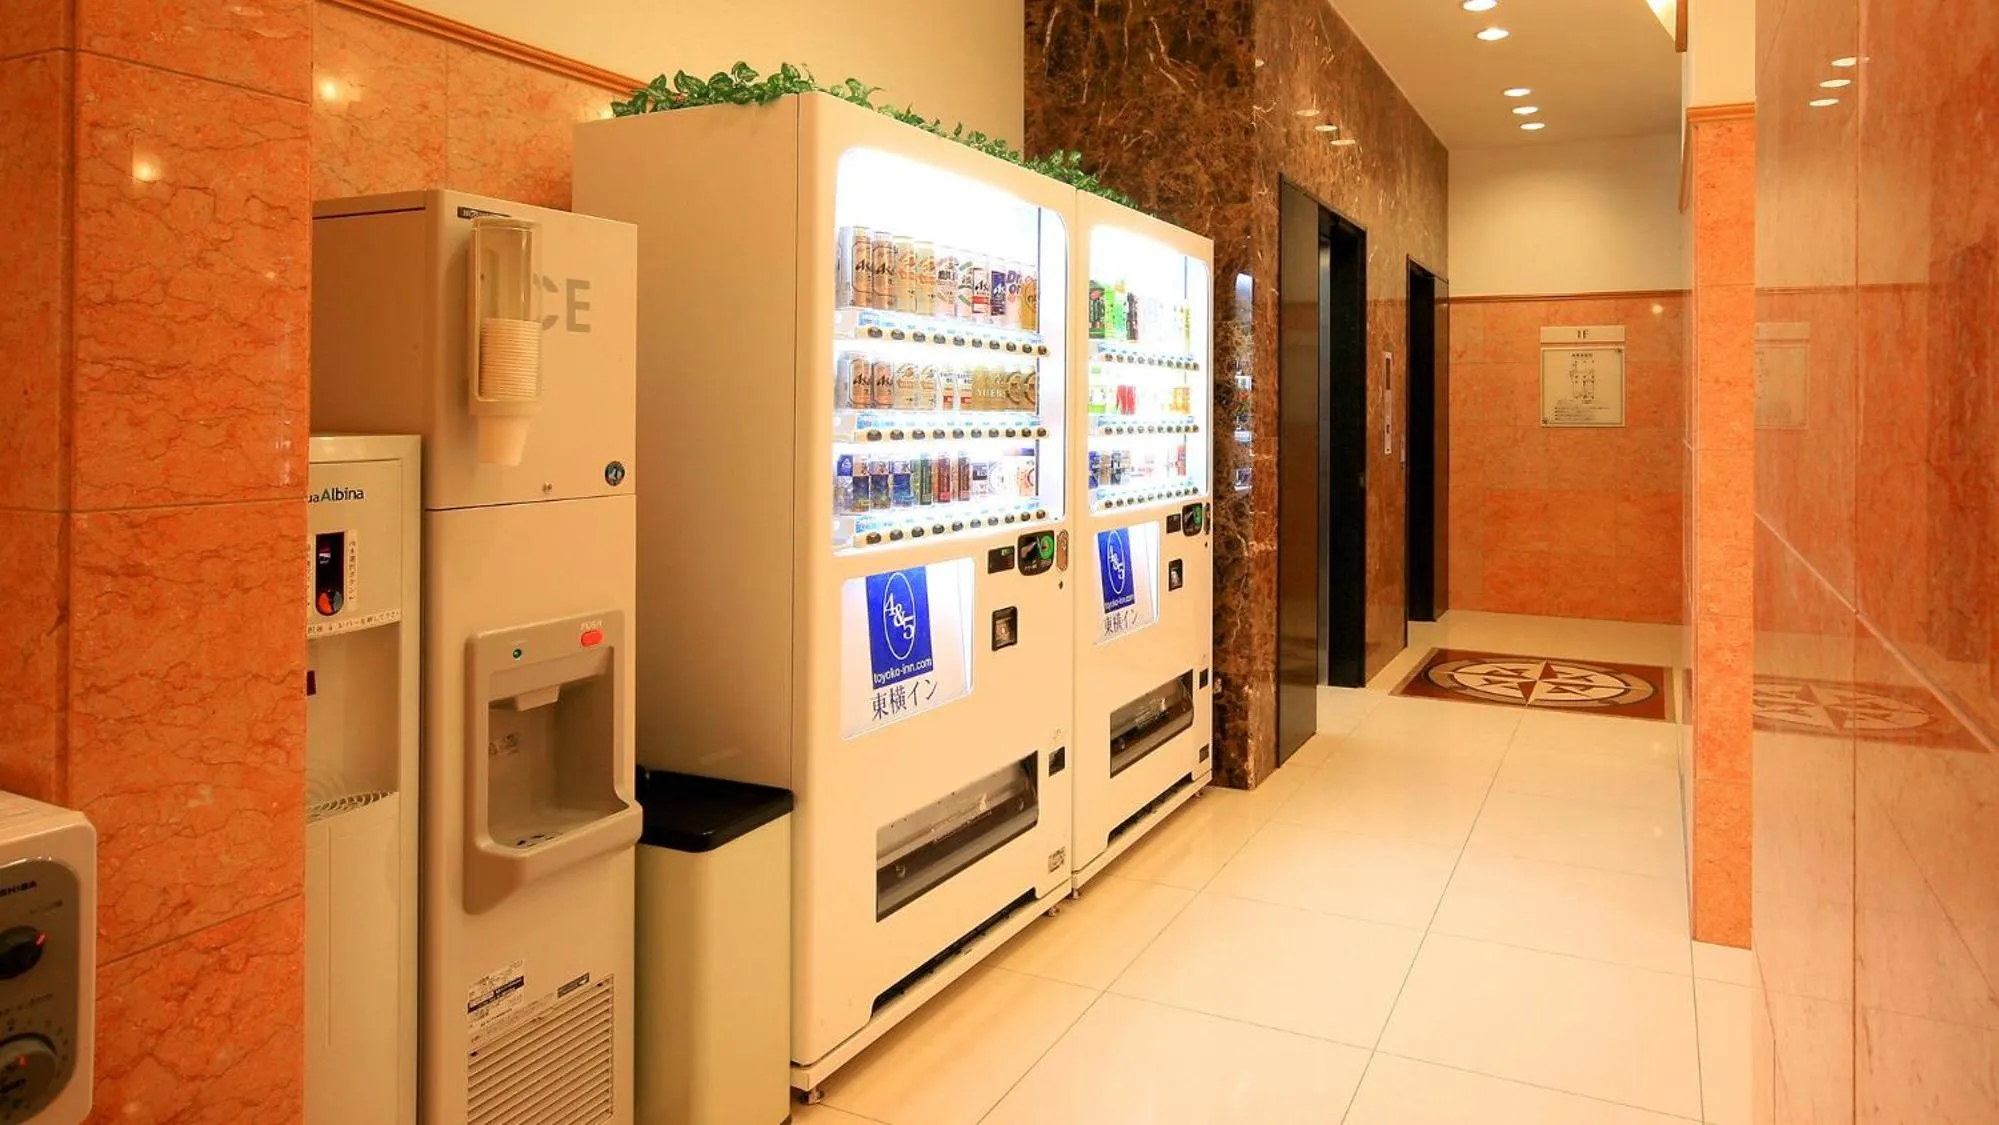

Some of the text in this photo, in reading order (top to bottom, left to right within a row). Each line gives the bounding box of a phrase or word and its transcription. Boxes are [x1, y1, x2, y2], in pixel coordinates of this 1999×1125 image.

[885, 593, 915, 640] 4&5
[873, 658, 933, 684] toyoko-inn.com
[870, 679, 939, 722] 東横イン
